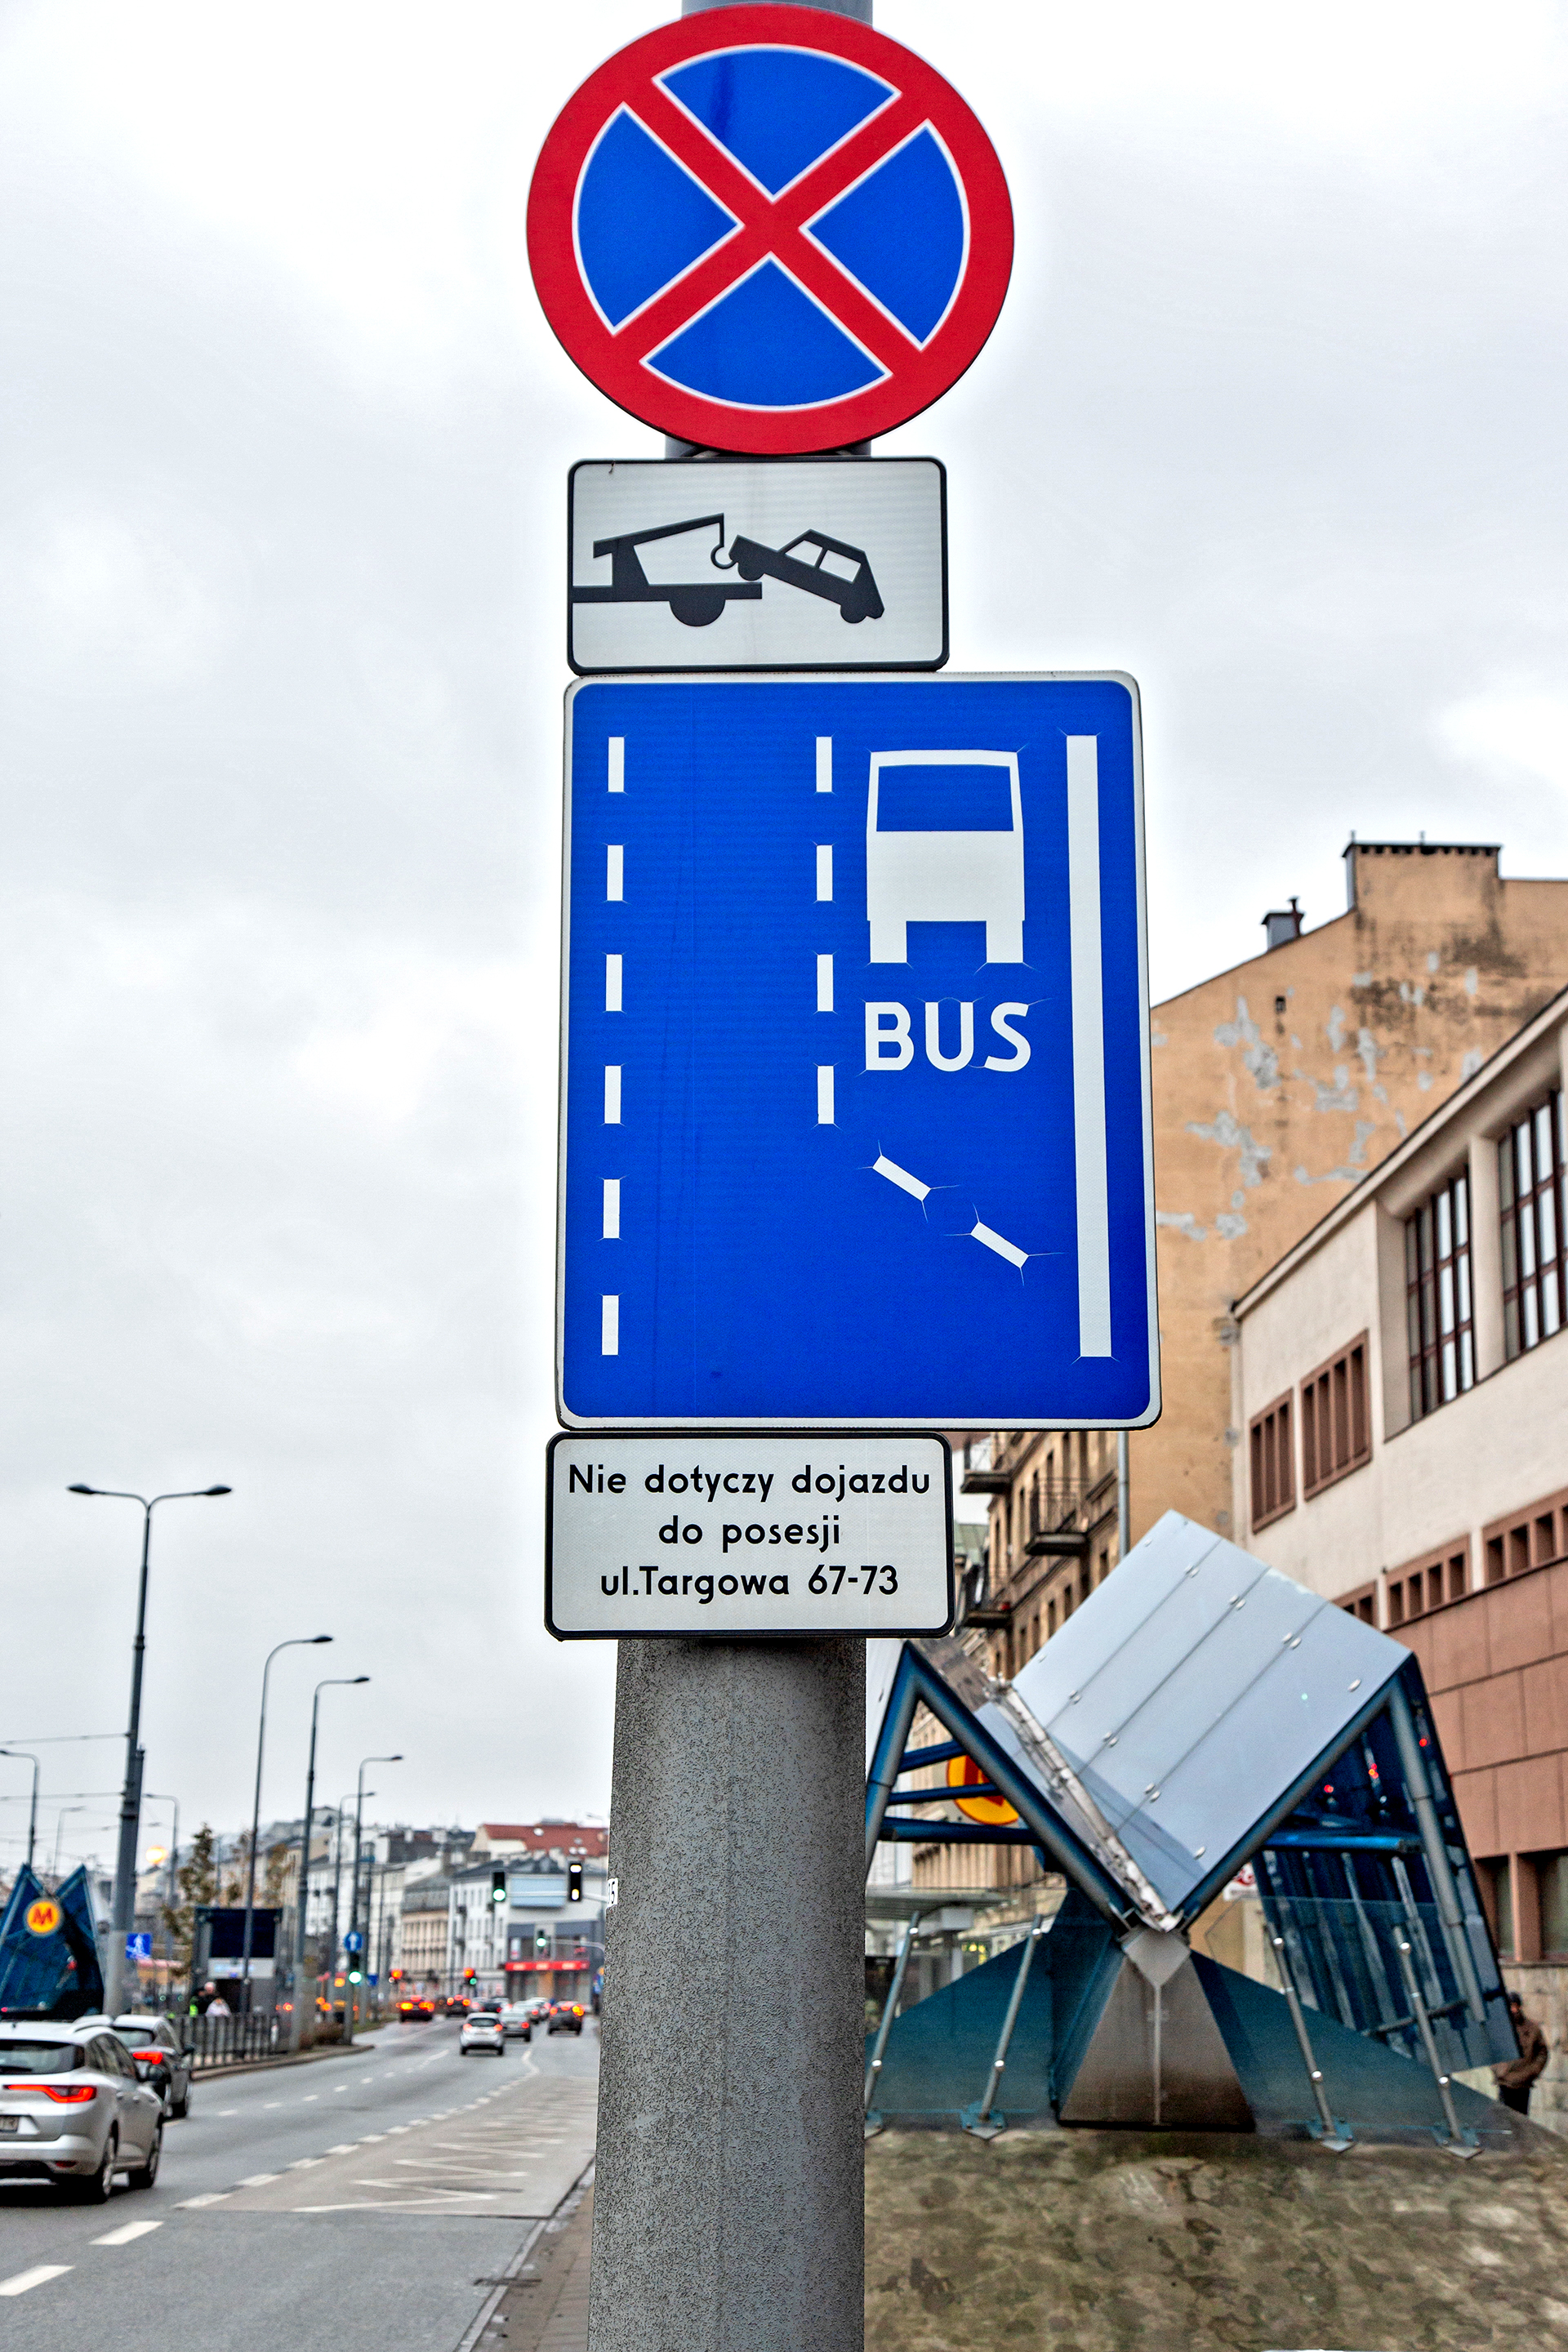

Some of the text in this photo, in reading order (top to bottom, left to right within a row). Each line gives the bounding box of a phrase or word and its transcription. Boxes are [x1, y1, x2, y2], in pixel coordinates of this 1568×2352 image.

[865, 1001, 1031, 1072] BUS
[569, 1464, 929, 1503] Nie dotyczy dojazdu
[658, 1515, 840, 1553] do posesji
[601, 1564, 898, 1605] ul.Targowa 67-73
[33, 1908, 53, 1925] M
